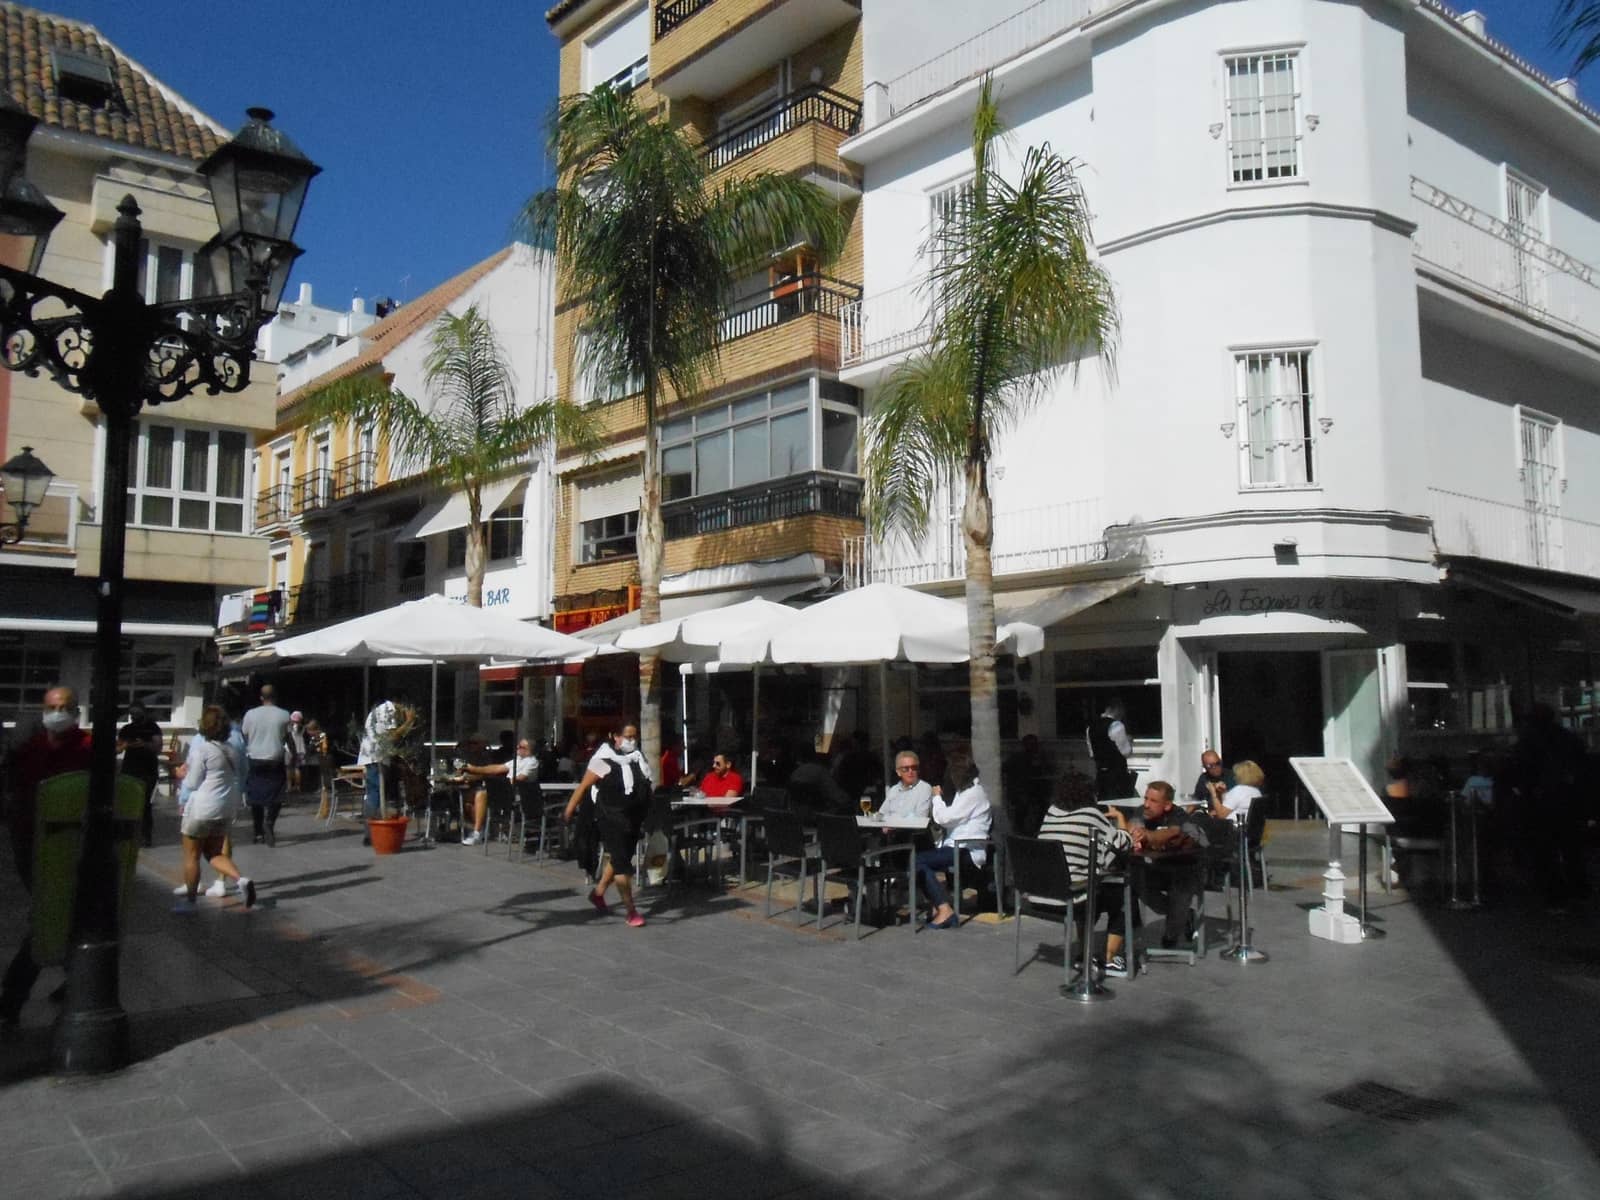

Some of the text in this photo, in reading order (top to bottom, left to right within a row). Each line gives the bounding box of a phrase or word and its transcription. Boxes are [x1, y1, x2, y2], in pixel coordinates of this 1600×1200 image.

[487, 588, 509, 606] BAR
[1203, 588, 1231, 614] La
[1240, 588, 1300, 613] Esquina
[1308, 590, 1326, 609] de
